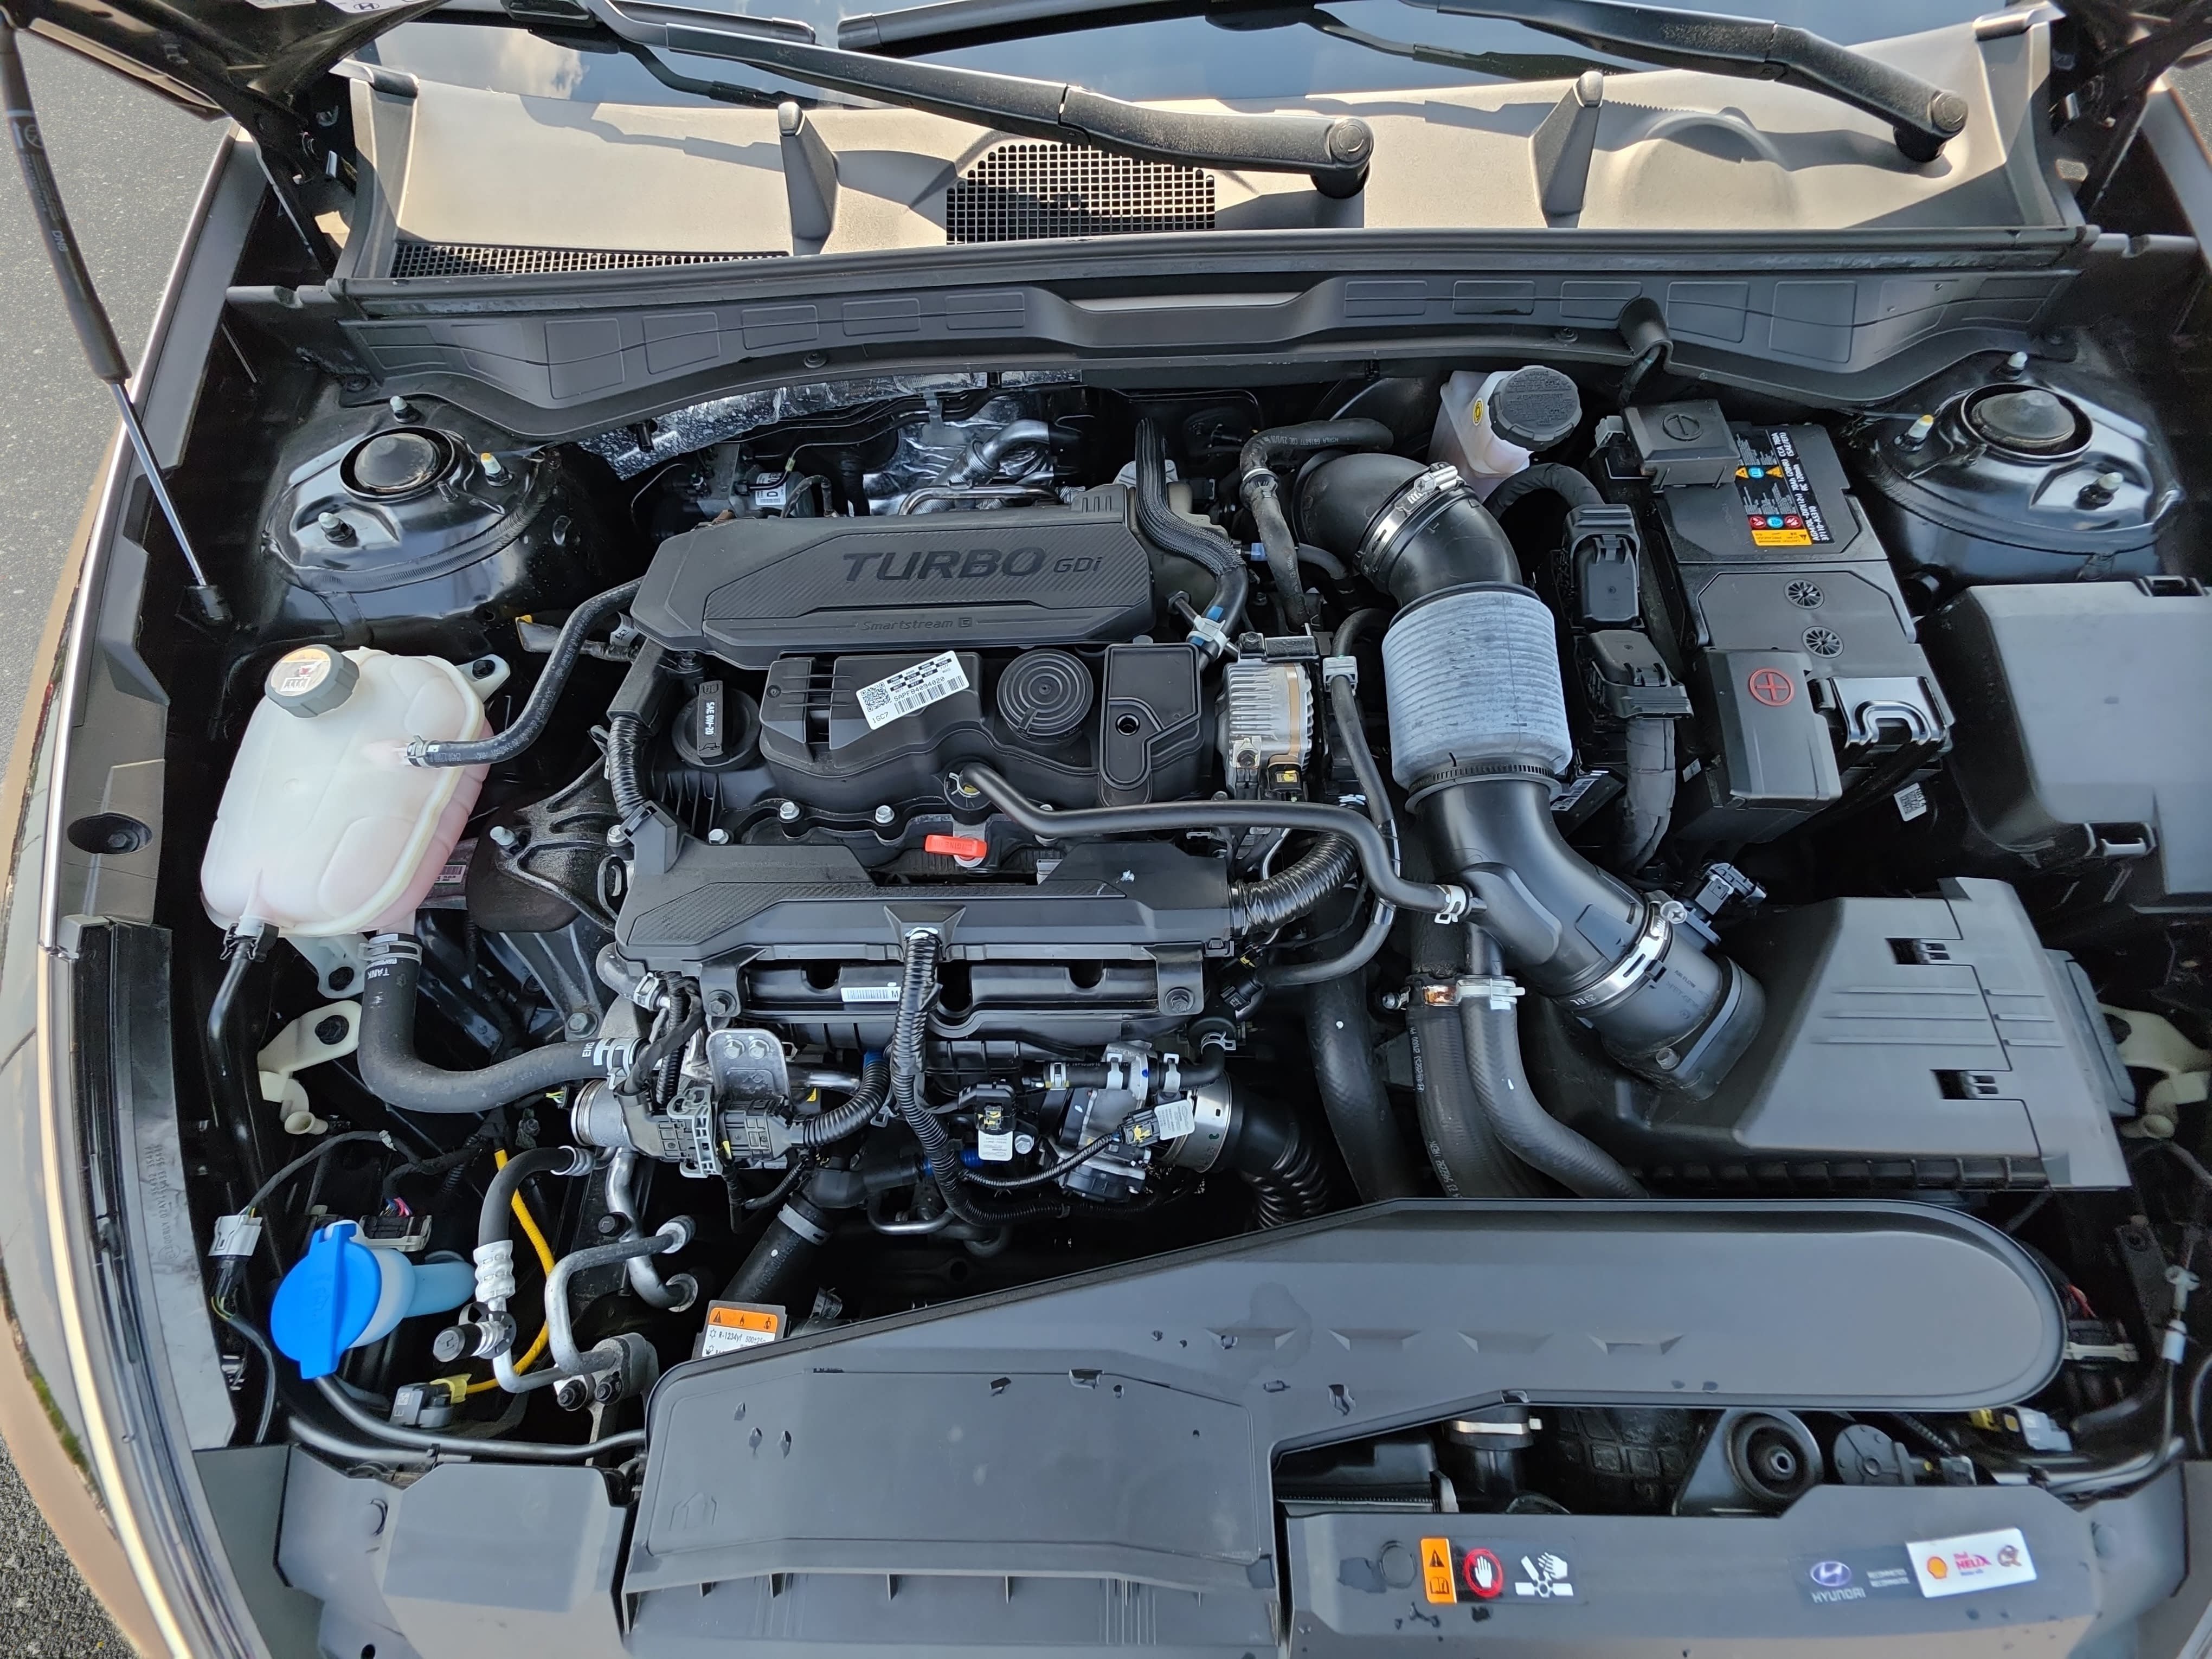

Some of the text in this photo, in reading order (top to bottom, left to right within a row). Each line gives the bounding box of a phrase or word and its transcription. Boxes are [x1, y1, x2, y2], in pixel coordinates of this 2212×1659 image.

[52, 230, 68, 252] DN8
[1777, 446, 1786, 458] CCA
[1801, 483, 1809, 492] RC
[843, 547, 1103, 582] TURBO GDi
[861, 620, 954, 631] Smartstream
[705, 702, 715, 735] SAE 0W-20
[872, 711, 890, 724] 1GC7
[367, 967, 390, 980] TANK
[581, 1042, 595, 1058] ENG
[718, 1332, 742, 1343] R-1234yf
[1811, 1587, 1867, 1604] HYUNDAI
